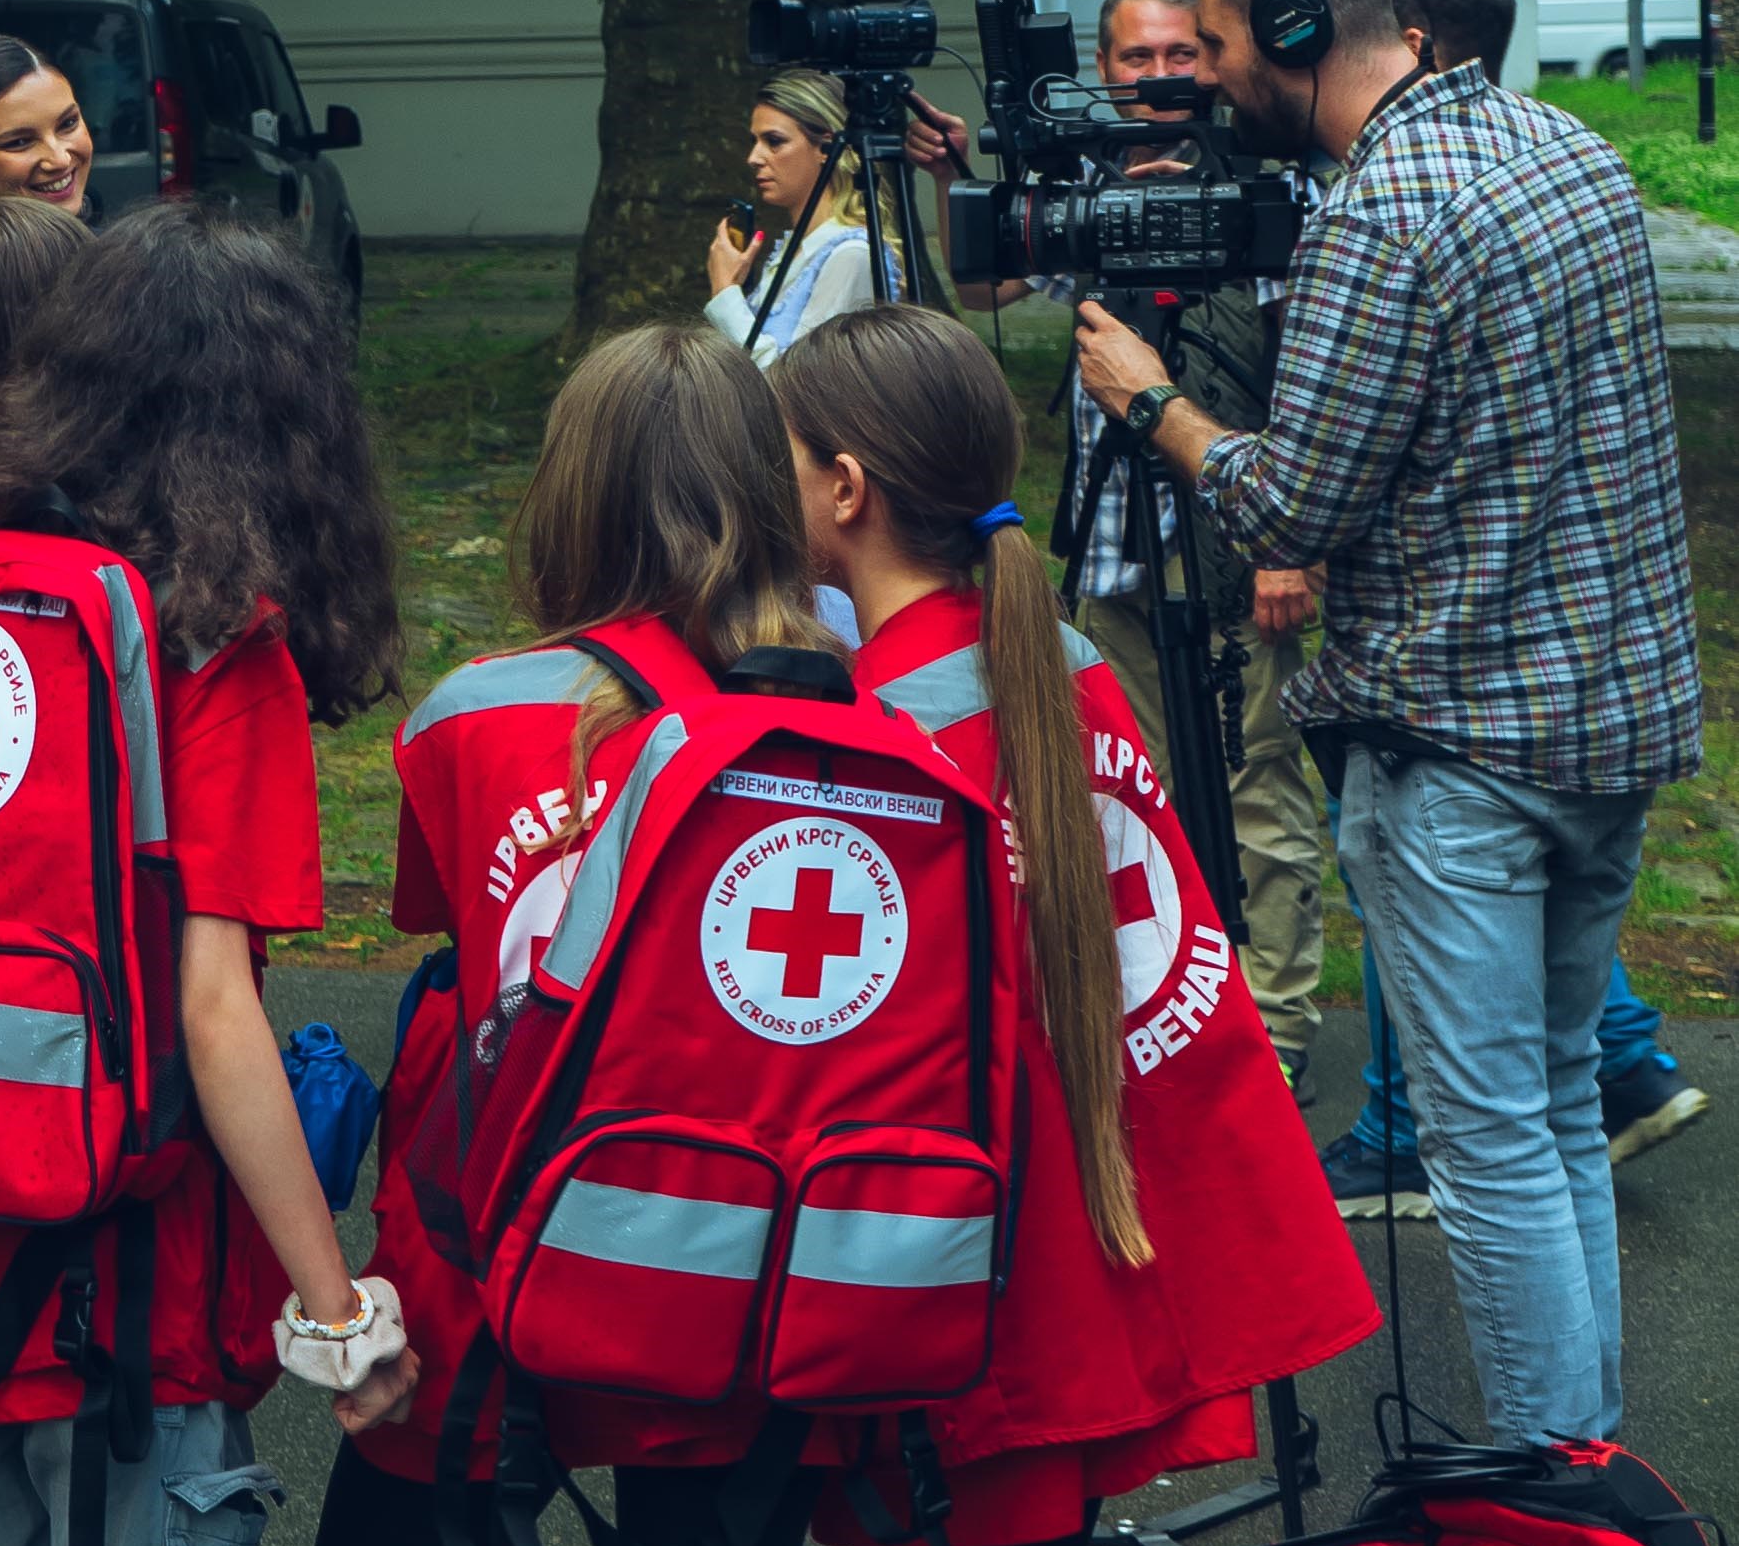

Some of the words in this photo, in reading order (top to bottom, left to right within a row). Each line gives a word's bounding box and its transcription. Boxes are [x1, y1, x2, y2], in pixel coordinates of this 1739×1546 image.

[781, 782, 820, 802] КРСТ
[824, 788, 884, 810] САВСКИ
[887, 797, 938, 819] ВЕНАЦ
[715, 833, 790, 907] ЦРВЕНИ
[796, 828, 845, 848] КРСТ
[847, 840, 898, 917] СРБИЈЕ
[714, 958, 741, 1000] RED
[739, 998, 797, 1035] CROSS
[801, 1018, 825, 1036] OF
[829, 970, 885, 1027] SERBIA
[1125, 924, 1230, 1076] ВЕНАЦ
